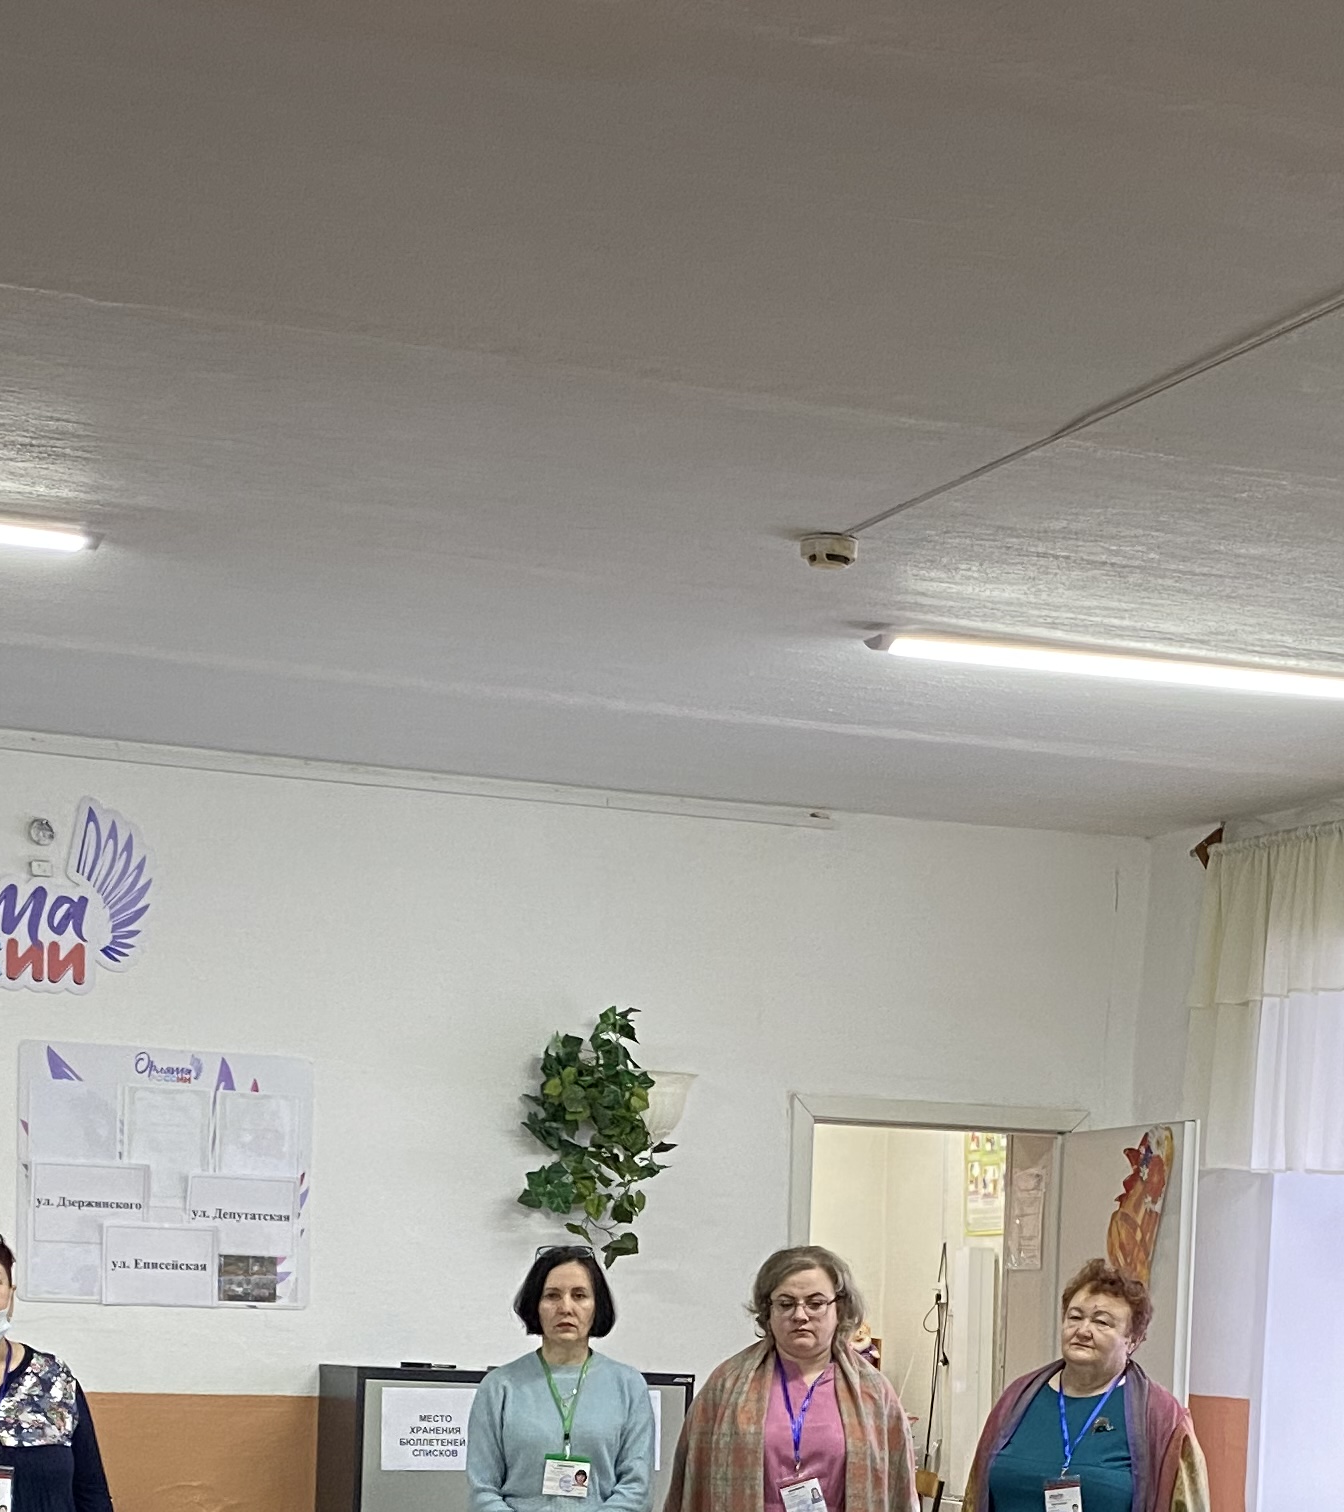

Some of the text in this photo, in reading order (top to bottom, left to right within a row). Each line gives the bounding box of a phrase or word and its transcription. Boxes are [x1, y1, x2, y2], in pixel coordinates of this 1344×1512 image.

[35, 1196, 143, 1211] ул. Дзержинского
[191, 1207, 291, 1224] ул. Депутатская
[111, 1257, 207, 1272] ул. Енисейская
[418, 1414, 453, 1423] МЕСТО
[409, 1426, 462, 1435] ХРАНЕНИЯ
[411, 1448, 459, 1458] СПИСКОВ
